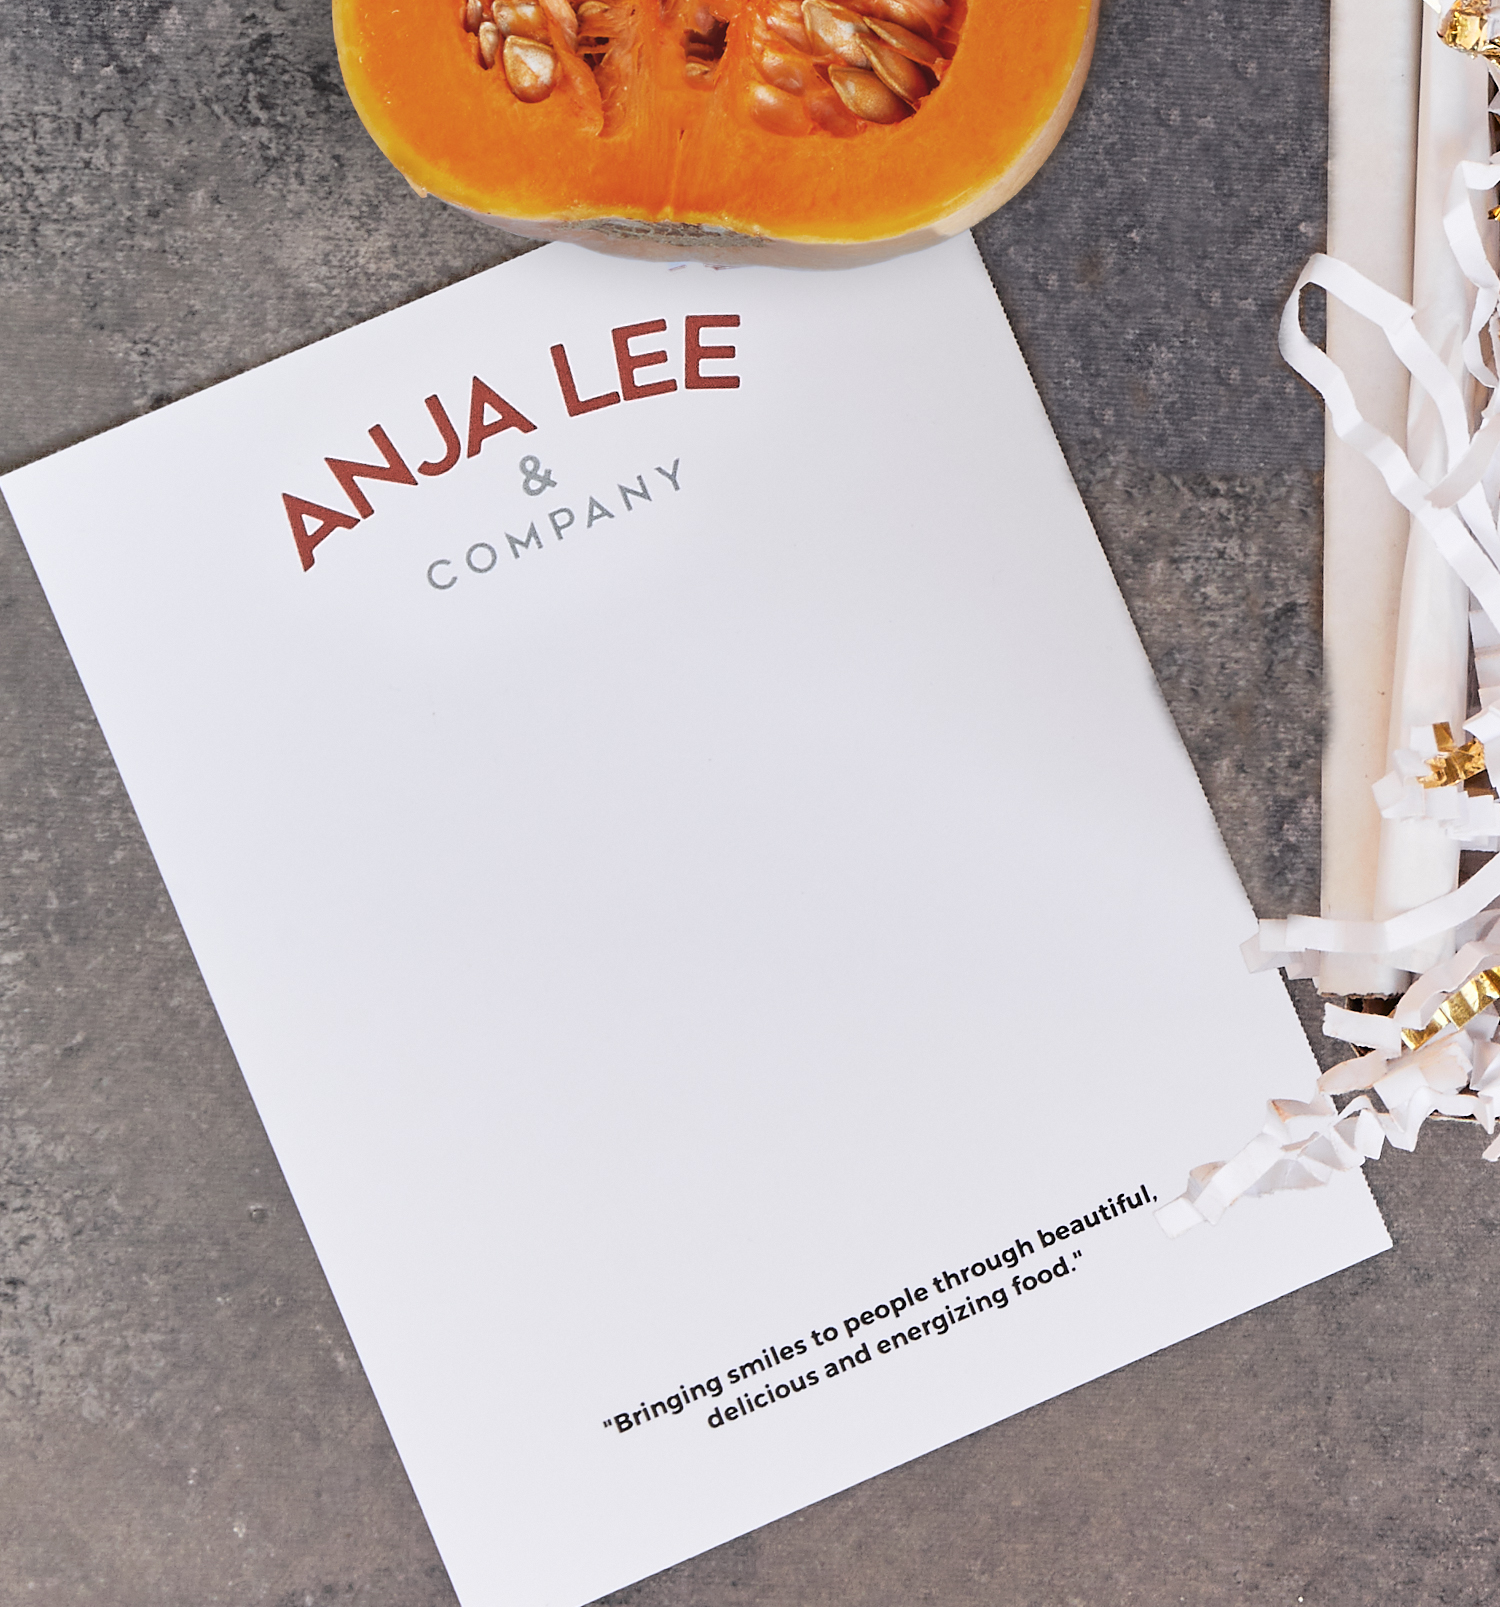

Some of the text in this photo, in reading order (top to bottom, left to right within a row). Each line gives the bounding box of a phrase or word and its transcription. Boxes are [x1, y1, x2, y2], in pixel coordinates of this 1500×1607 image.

[281, 314, 741, 572] ANJA LEE
[427, 458, 680, 590] COMPANY
[519, 455, 557, 496] &
[603, 1184, 1157, 1433] "Bringing smiles to people through beautiful,
[708, 1250, 1082, 1428] delicious and energizing food."
